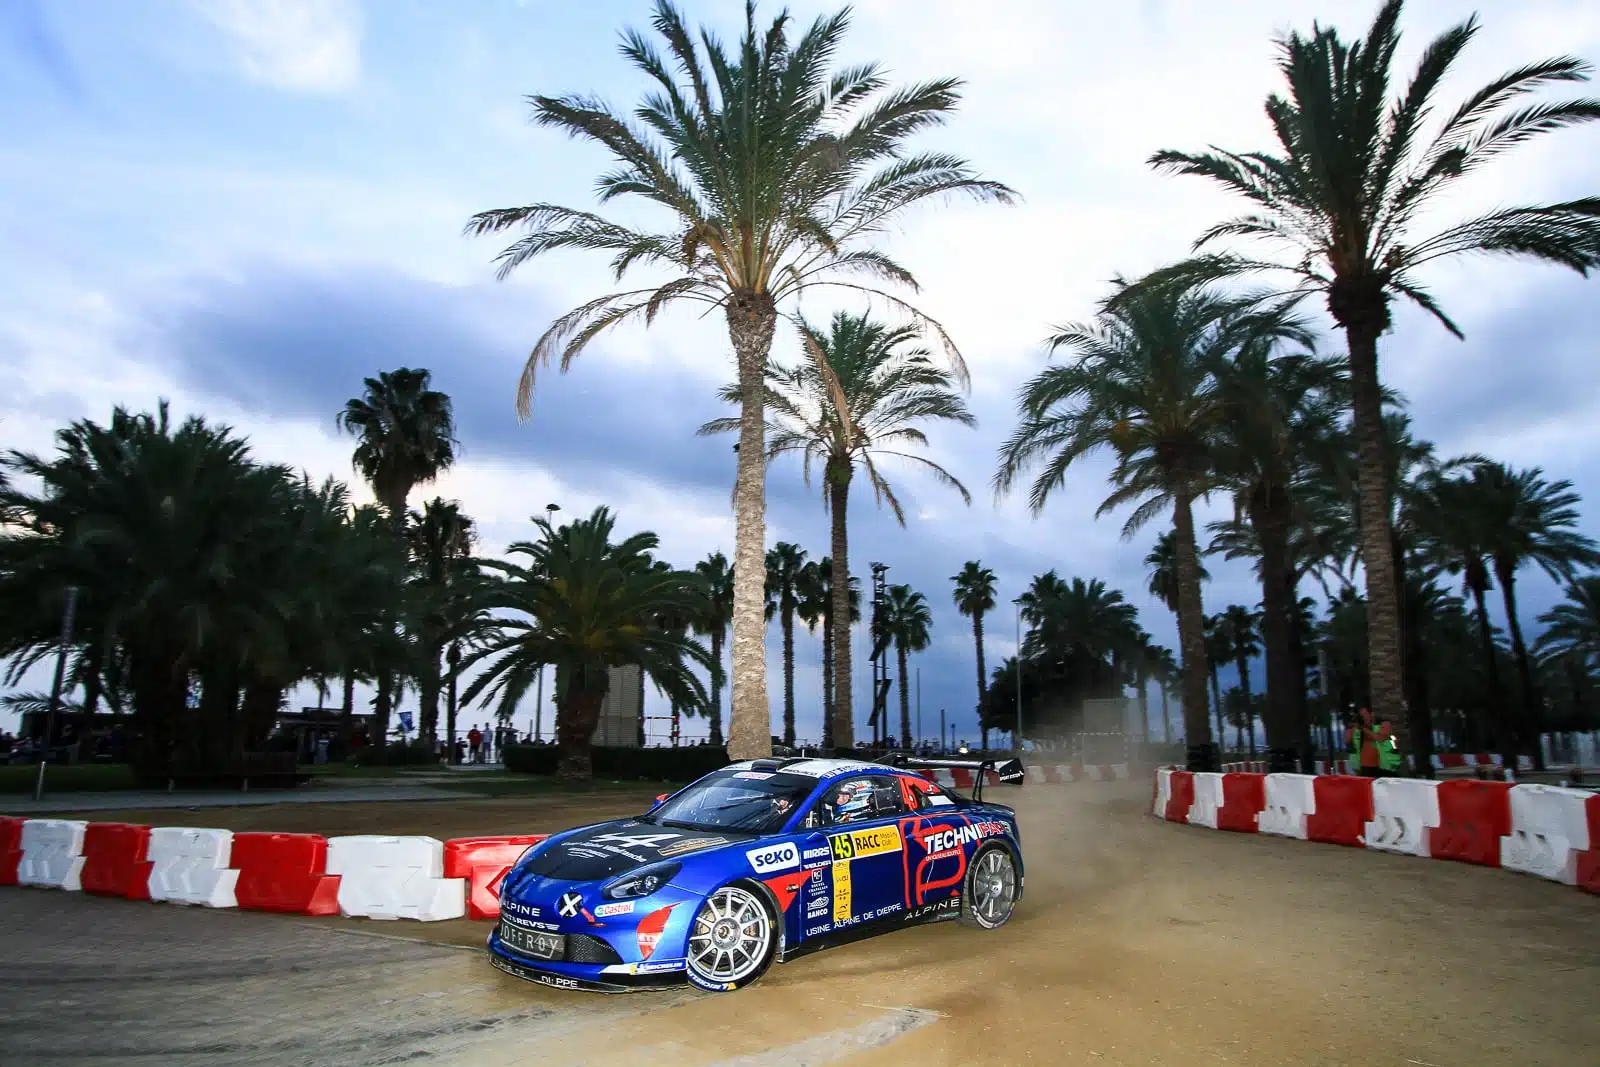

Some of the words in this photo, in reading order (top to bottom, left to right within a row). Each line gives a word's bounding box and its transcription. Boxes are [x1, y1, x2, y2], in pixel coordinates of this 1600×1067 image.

[834, 834, 852, 859] 45
[856, 834, 880, 850] RACC
[604, 903, 632, 915] Castrol
[904, 898, 960, 921] ALPINE
[806, 923, 831, 936] USINE
[834, 915, 861, 929] ALPINE
[863, 911, 875, 921] DE
[876, 903, 902, 917] DIEPPE
[541, 975, 579, 988] DIPPE
